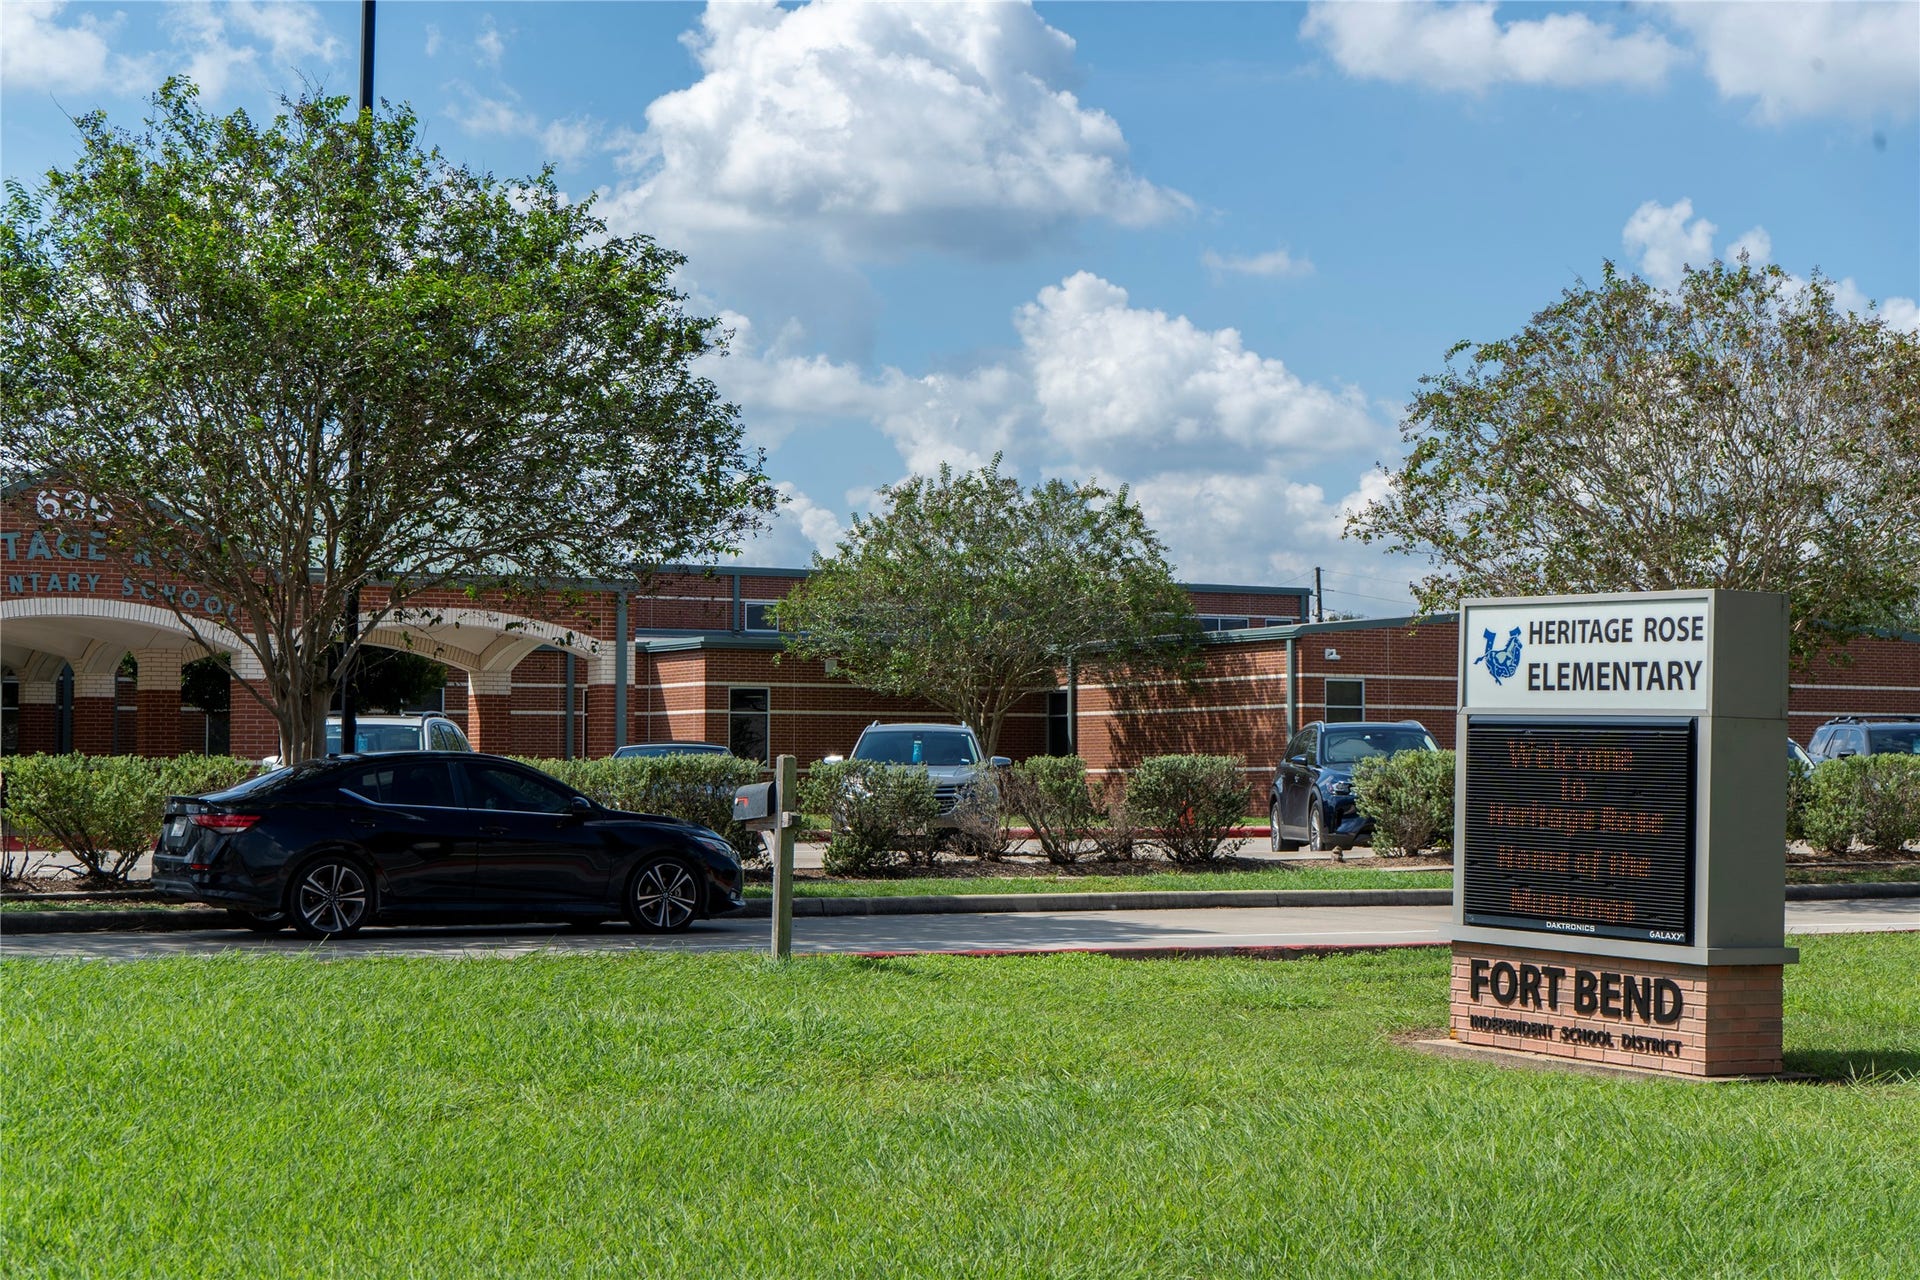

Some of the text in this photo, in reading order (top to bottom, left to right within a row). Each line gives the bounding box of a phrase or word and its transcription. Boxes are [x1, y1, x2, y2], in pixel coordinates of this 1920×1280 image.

[0, 531, 107, 561] TAGE
[9, 573, 237, 623] NTARY SCHOOL
[1528, 615, 1704, 645] HERITAGE ROSE
[1528, 660, 1702, 691] ELEMENTARY
[1506, 737, 1633, 771] Welcome
[1488, 800, 1664, 837] Heritage Rose
[1497, 844, 1569, 872] Home
[1607, 849, 1652, 877] the
[1546, 920, 1596, 933] DAKTRONICS
[1649, 930, 1683, 941] GALAXY
[1470, 959, 1684, 1024] FORT BEND
[1470, 1014, 1683, 1057] INDEPENDENT SCHOOL DISTRICT
